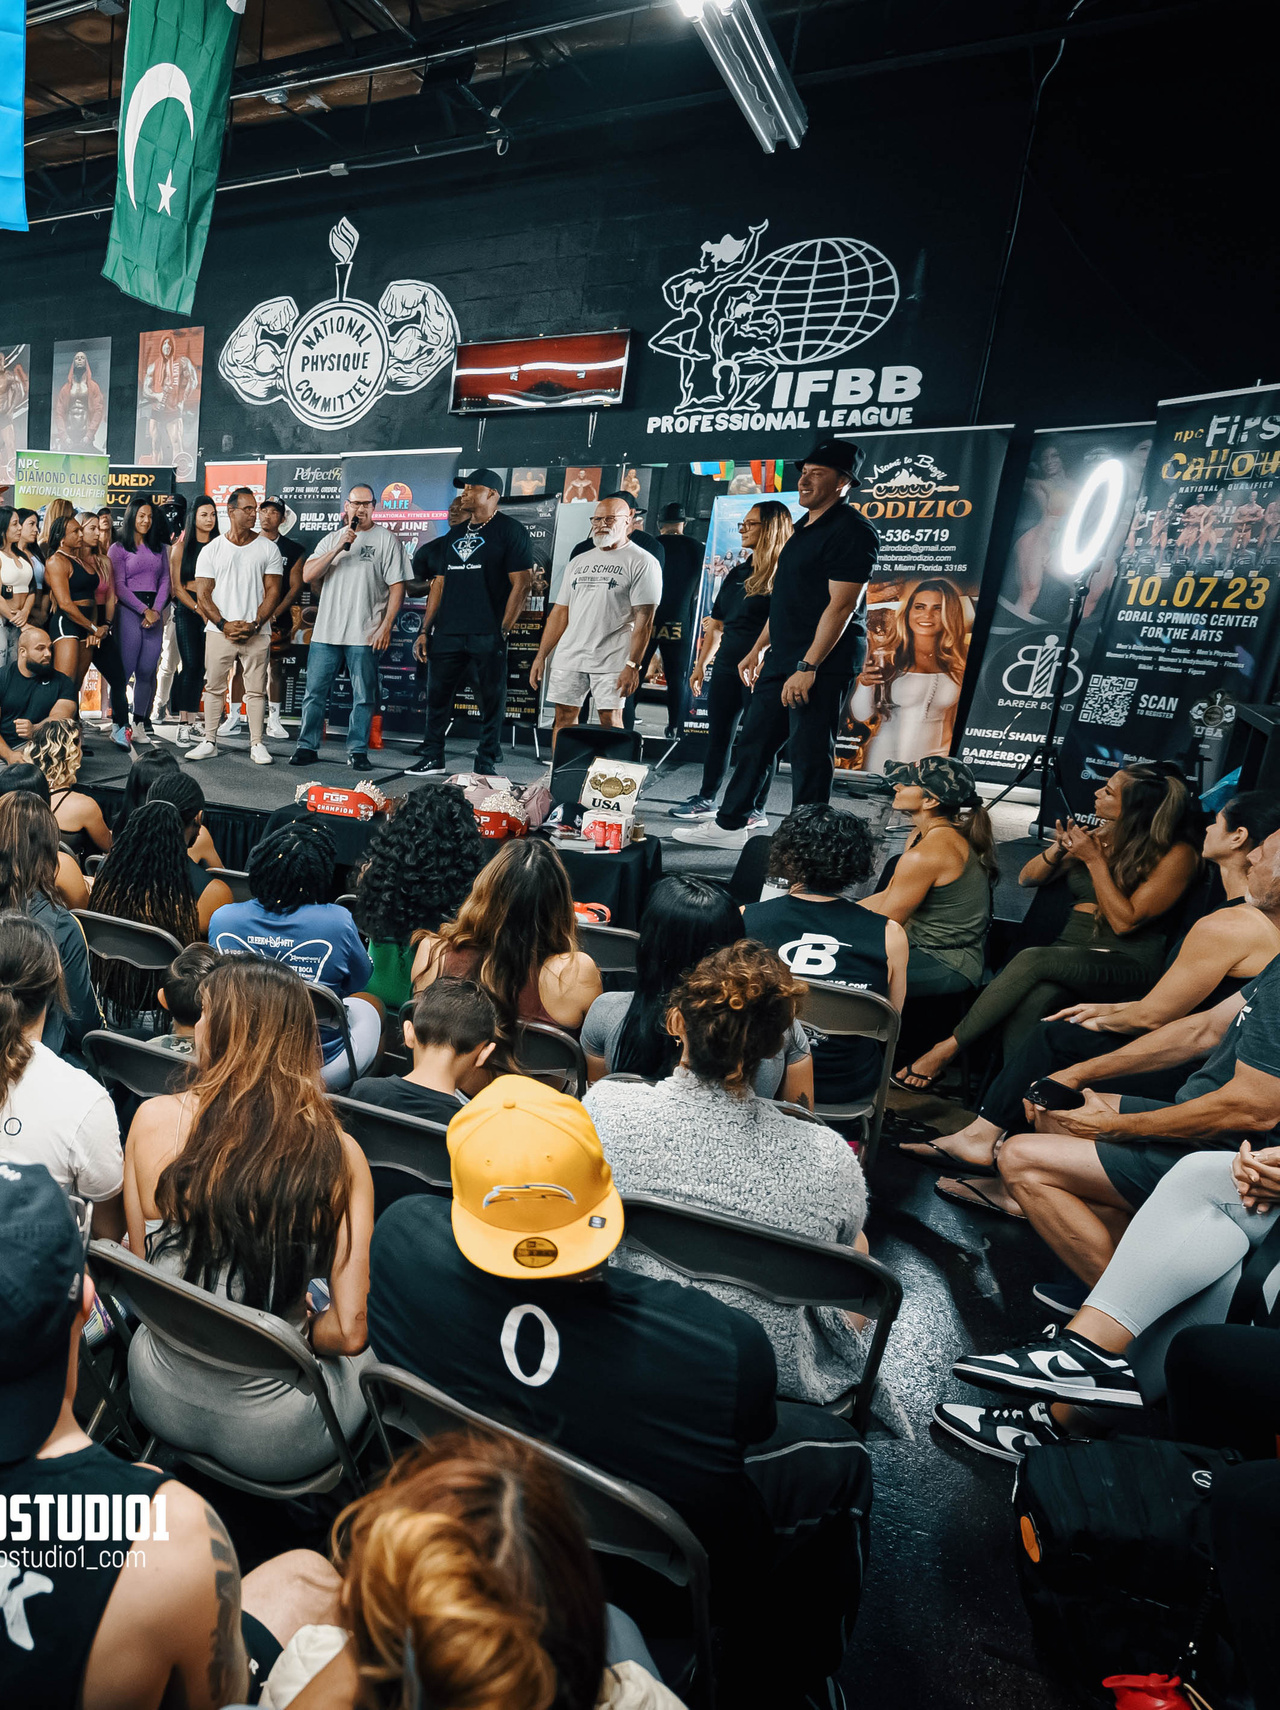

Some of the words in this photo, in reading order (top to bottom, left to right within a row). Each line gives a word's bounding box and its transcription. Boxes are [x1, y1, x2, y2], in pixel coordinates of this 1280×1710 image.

[301, 316, 372, 350] NATIONAL
[301, 352, 370, 372] PHYSIQUE
[295, 374, 372, 412] COMMITTEE
[772, 366, 923, 409] IFBB
[647, 412, 810, 433] PROFESSIONAL
[818, 407, 913, 428] LEAGUE
[1174, 429, 1205, 443] npc
[18, 459, 39, 470] NPC
[904, 456, 913, 464] to
[17, 470, 66, 485] DIAMOND
[69, 473, 107, 487] CLASSIC
[18, 486, 61, 497] NATIONAL
[64, 487, 106, 498] QUALIFIER
[1178, 484, 1219, 493] NATIONAL
[1227, 481, 1274, 491] QUALIFIER
[300, 512, 325, 522] BUILD
[300, 522, 338, 531] PERFECT
[400, 521, 428, 532] JUNE
[592, 564, 624, 575] SCHOOL
[917, 563, 942, 571] Florida
[1125, 575, 1270, 610] 10.07.23
[1117, 610, 1154, 623] CORAL
[1156, 612, 1208, 626] SPRINGS
[1210, 614, 1259, 628] CENTER
[1140, 626, 1163, 638] FOR
[1165, 628, 1189, 640] THE
[1190, 631, 1224, 642] ARTS
[997, 698, 1037, 709] BARBER
[1139, 694, 1179, 712] SCAN
[965, 727, 1006, 740] UNISEX
[323, 792, 349, 802] FGP
[317, 804, 354, 815] CHAMPION
[592, 797, 622, 811] USA
